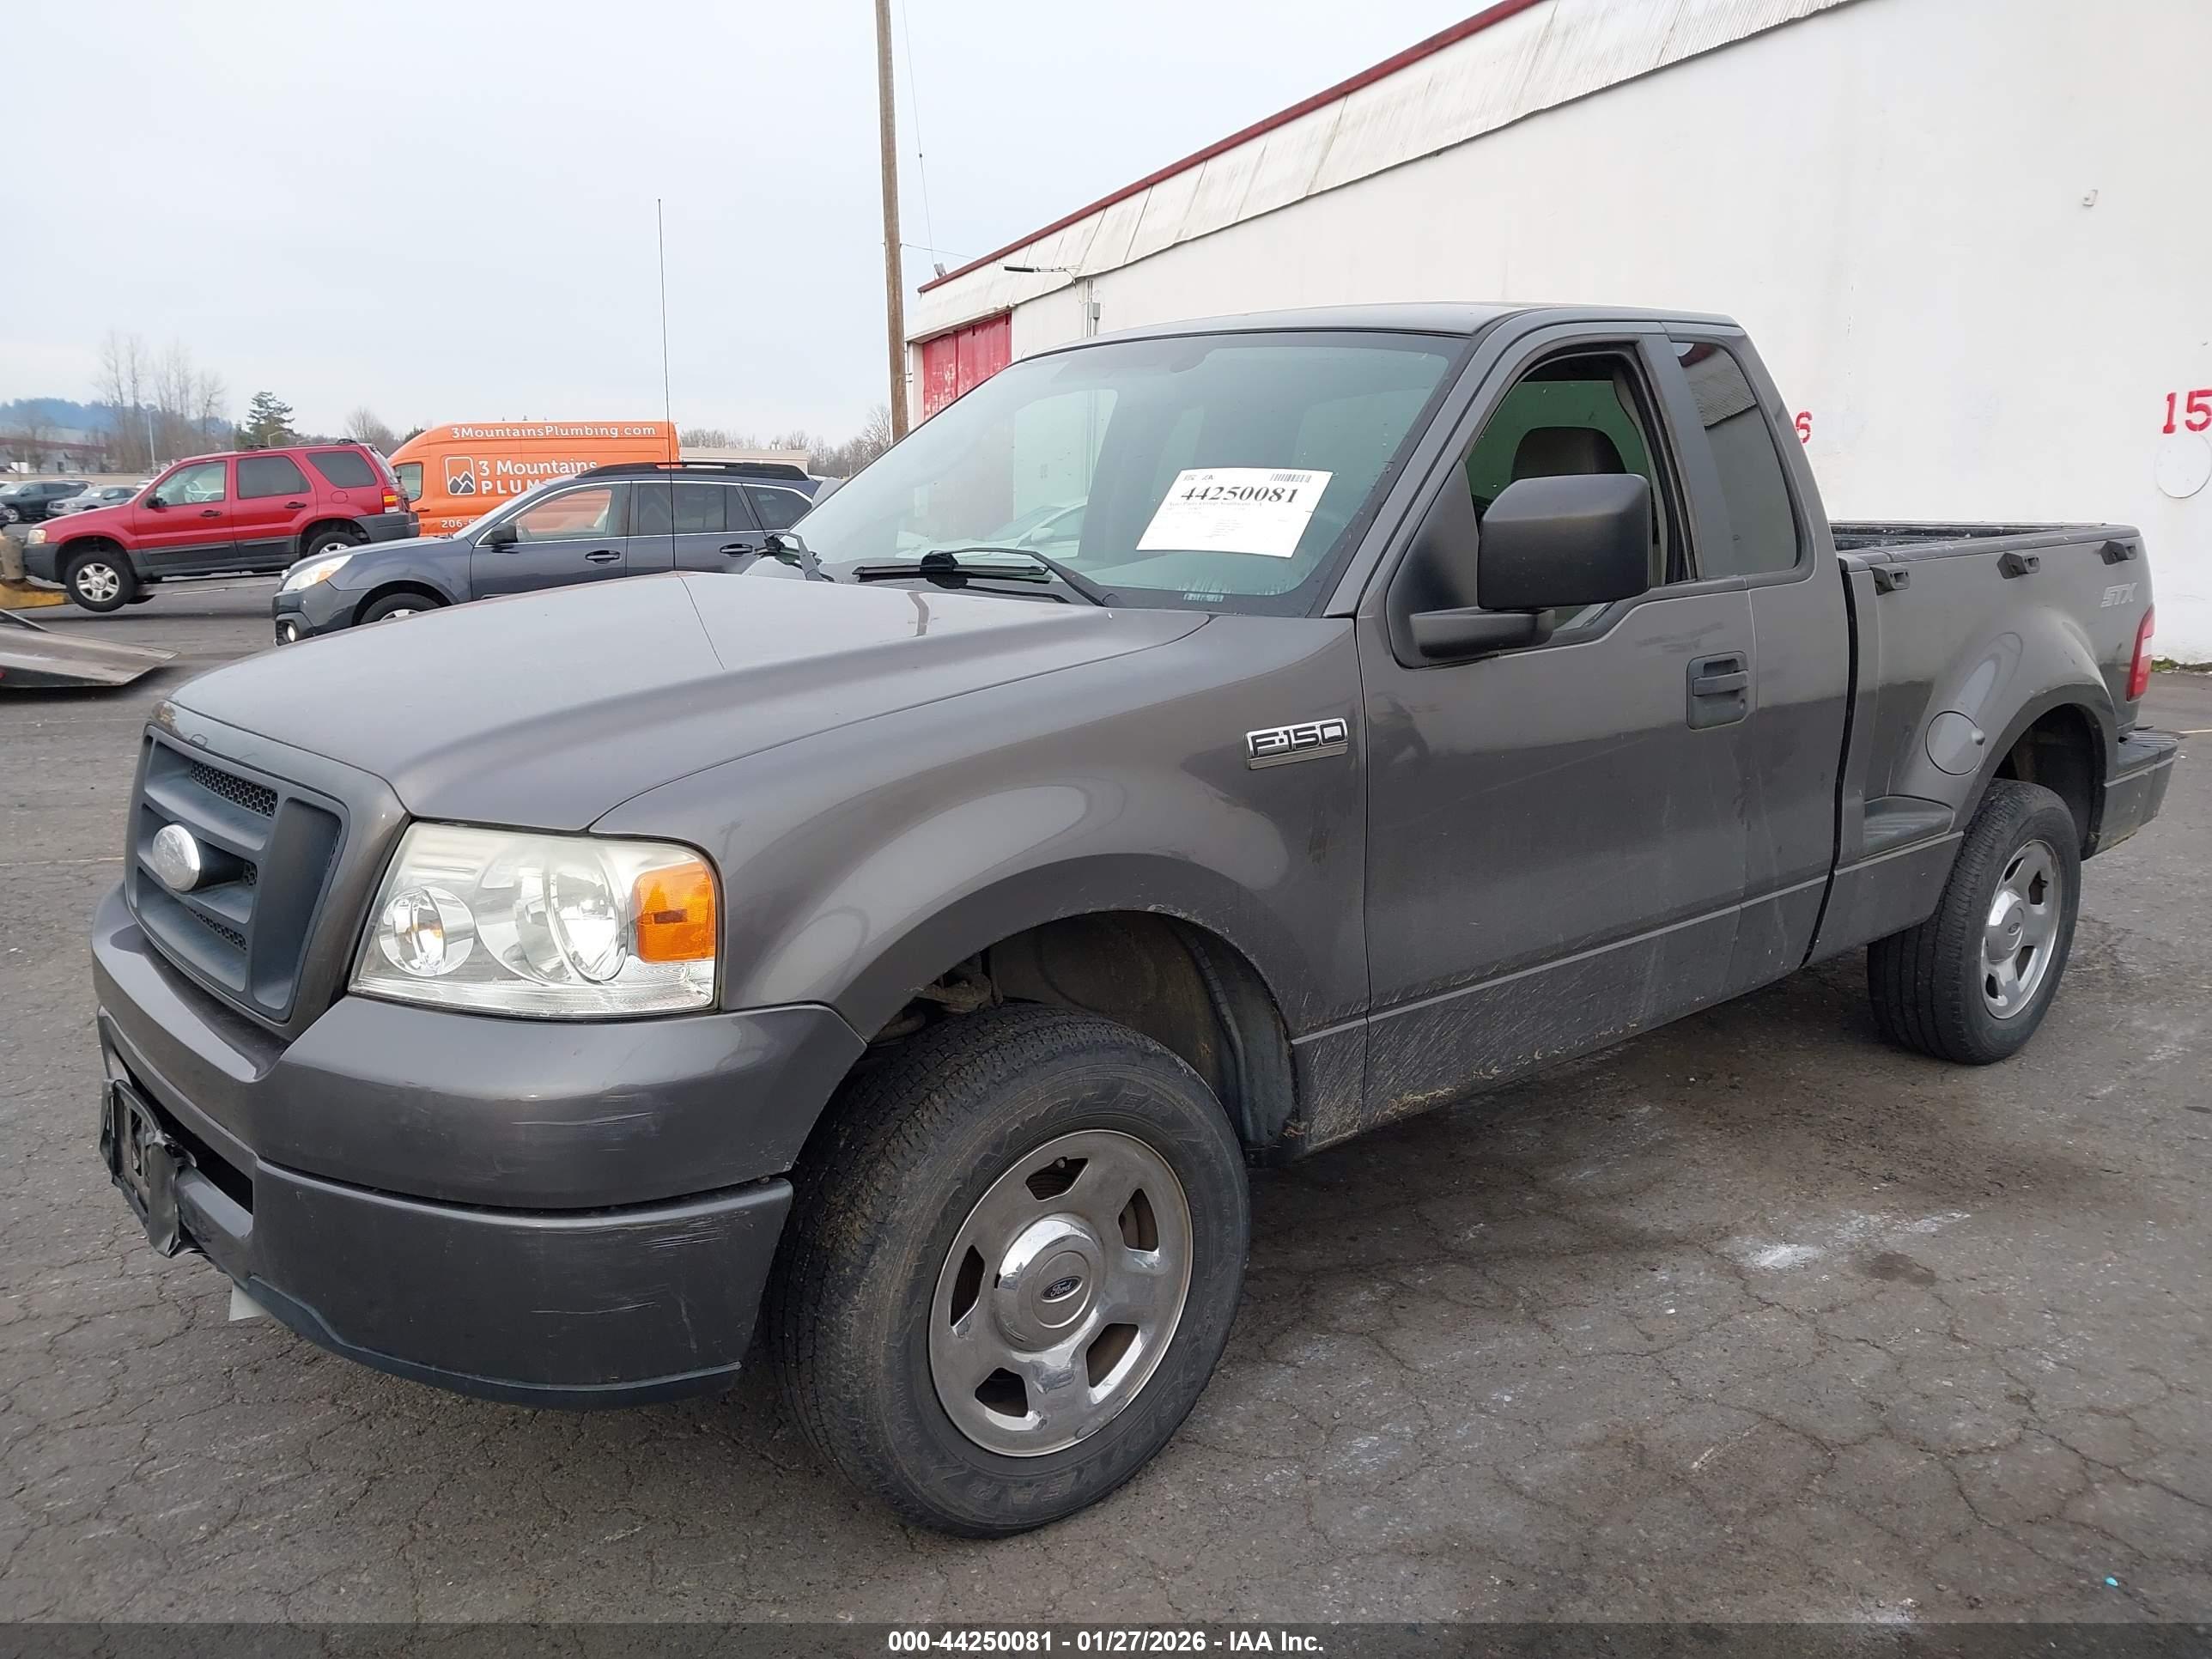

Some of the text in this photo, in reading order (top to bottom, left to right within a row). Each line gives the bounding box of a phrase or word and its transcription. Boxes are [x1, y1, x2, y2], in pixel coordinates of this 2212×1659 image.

[2163, 389, 2212, 434] 15
[452, 425, 656, 439] 3MountainsPlumbing.com
[1796, 411, 1813, 444] 6
[478, 459, 598, 476] 3 Mountains
[1182, 486, 1298, 503] 44250081
[2100, 583, 2137, 608] STX
[1250, 720, 1346, 757] F-150
[1049, 1280, 1073, 1297] Ford
